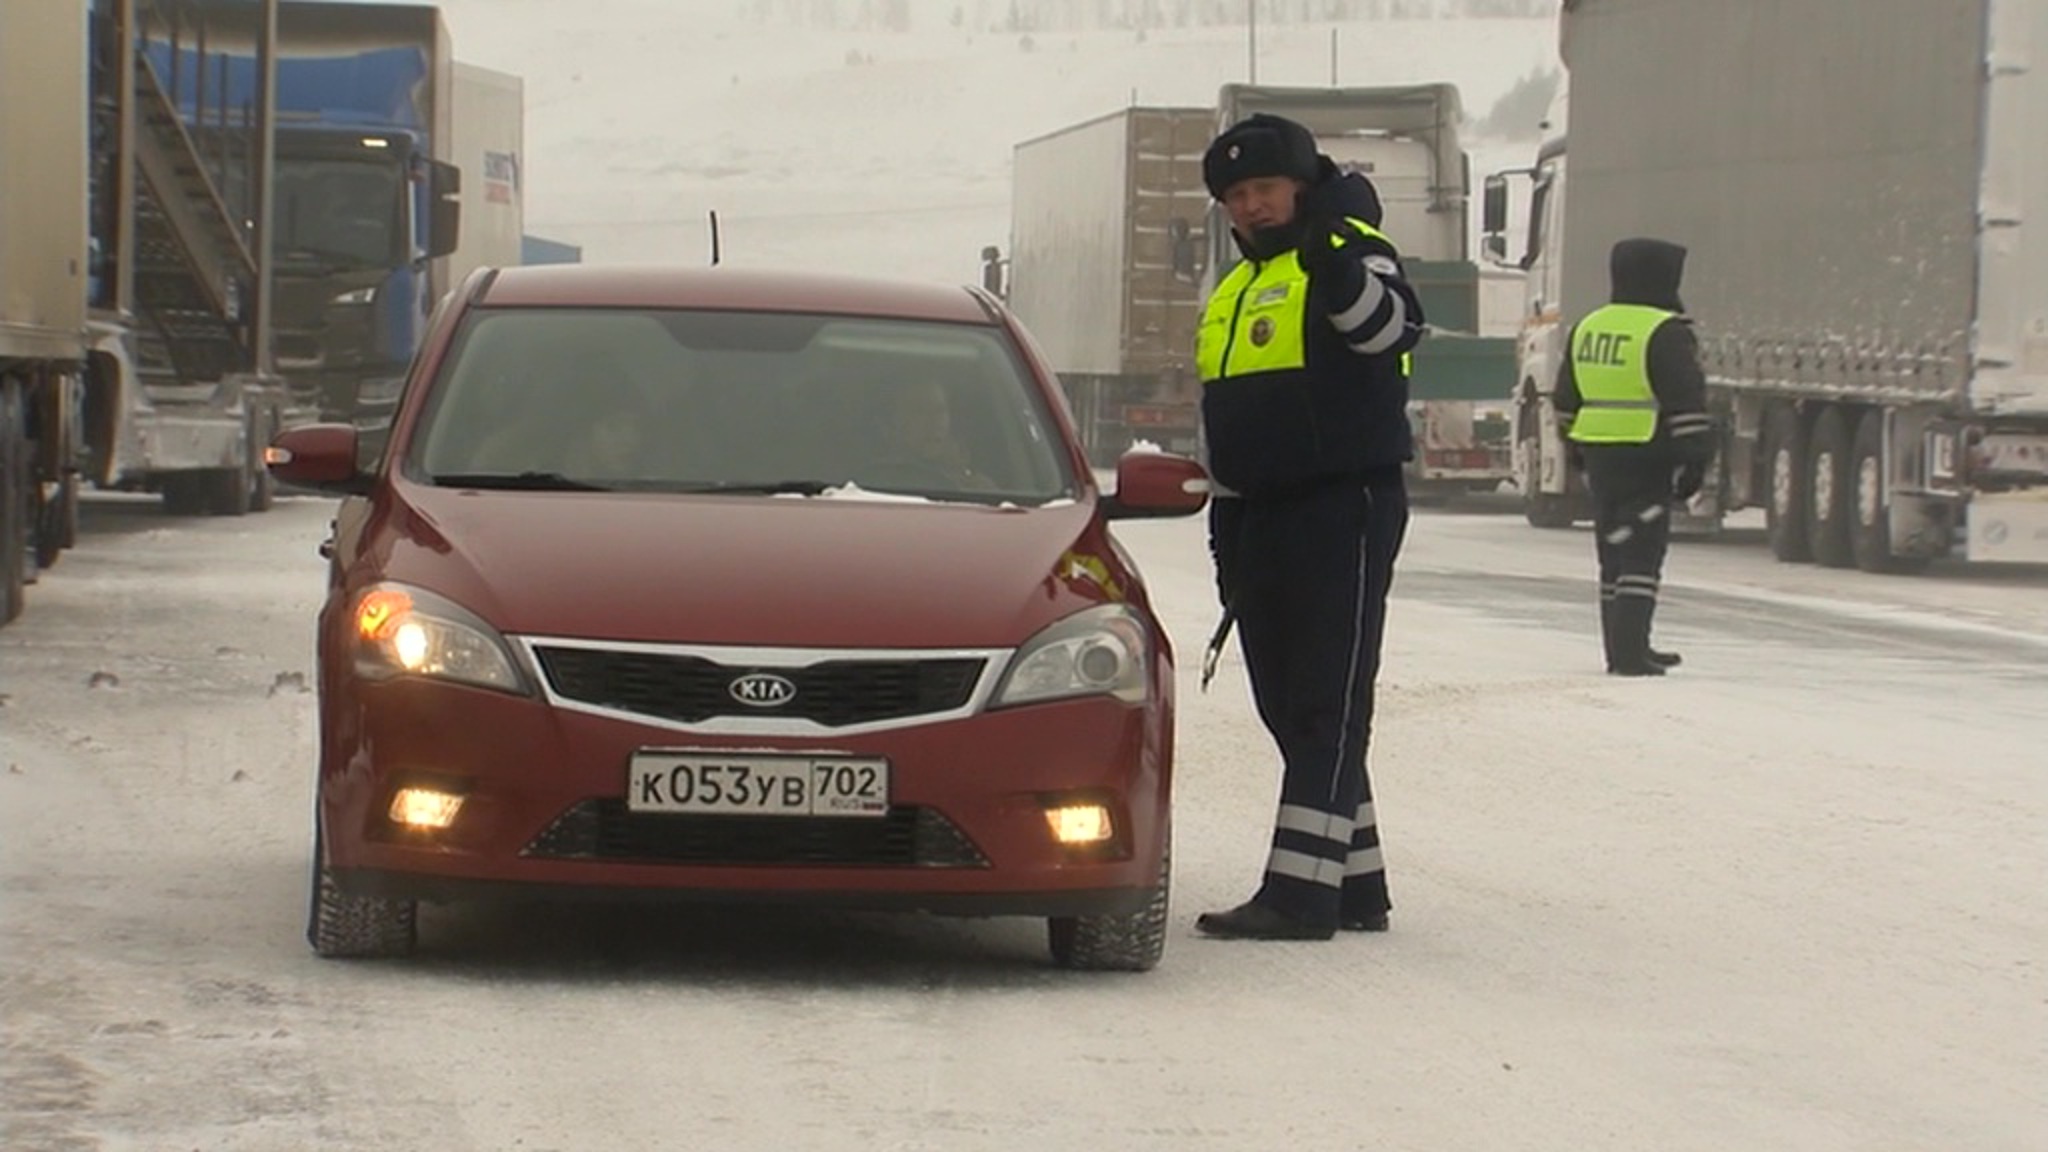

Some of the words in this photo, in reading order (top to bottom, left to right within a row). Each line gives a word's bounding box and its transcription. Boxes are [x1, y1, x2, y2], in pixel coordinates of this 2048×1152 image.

[1577, 332, 1632, 366] ДПС
[741, 680, 785, 699] KIA
[816, 766, 877, 797] 702
